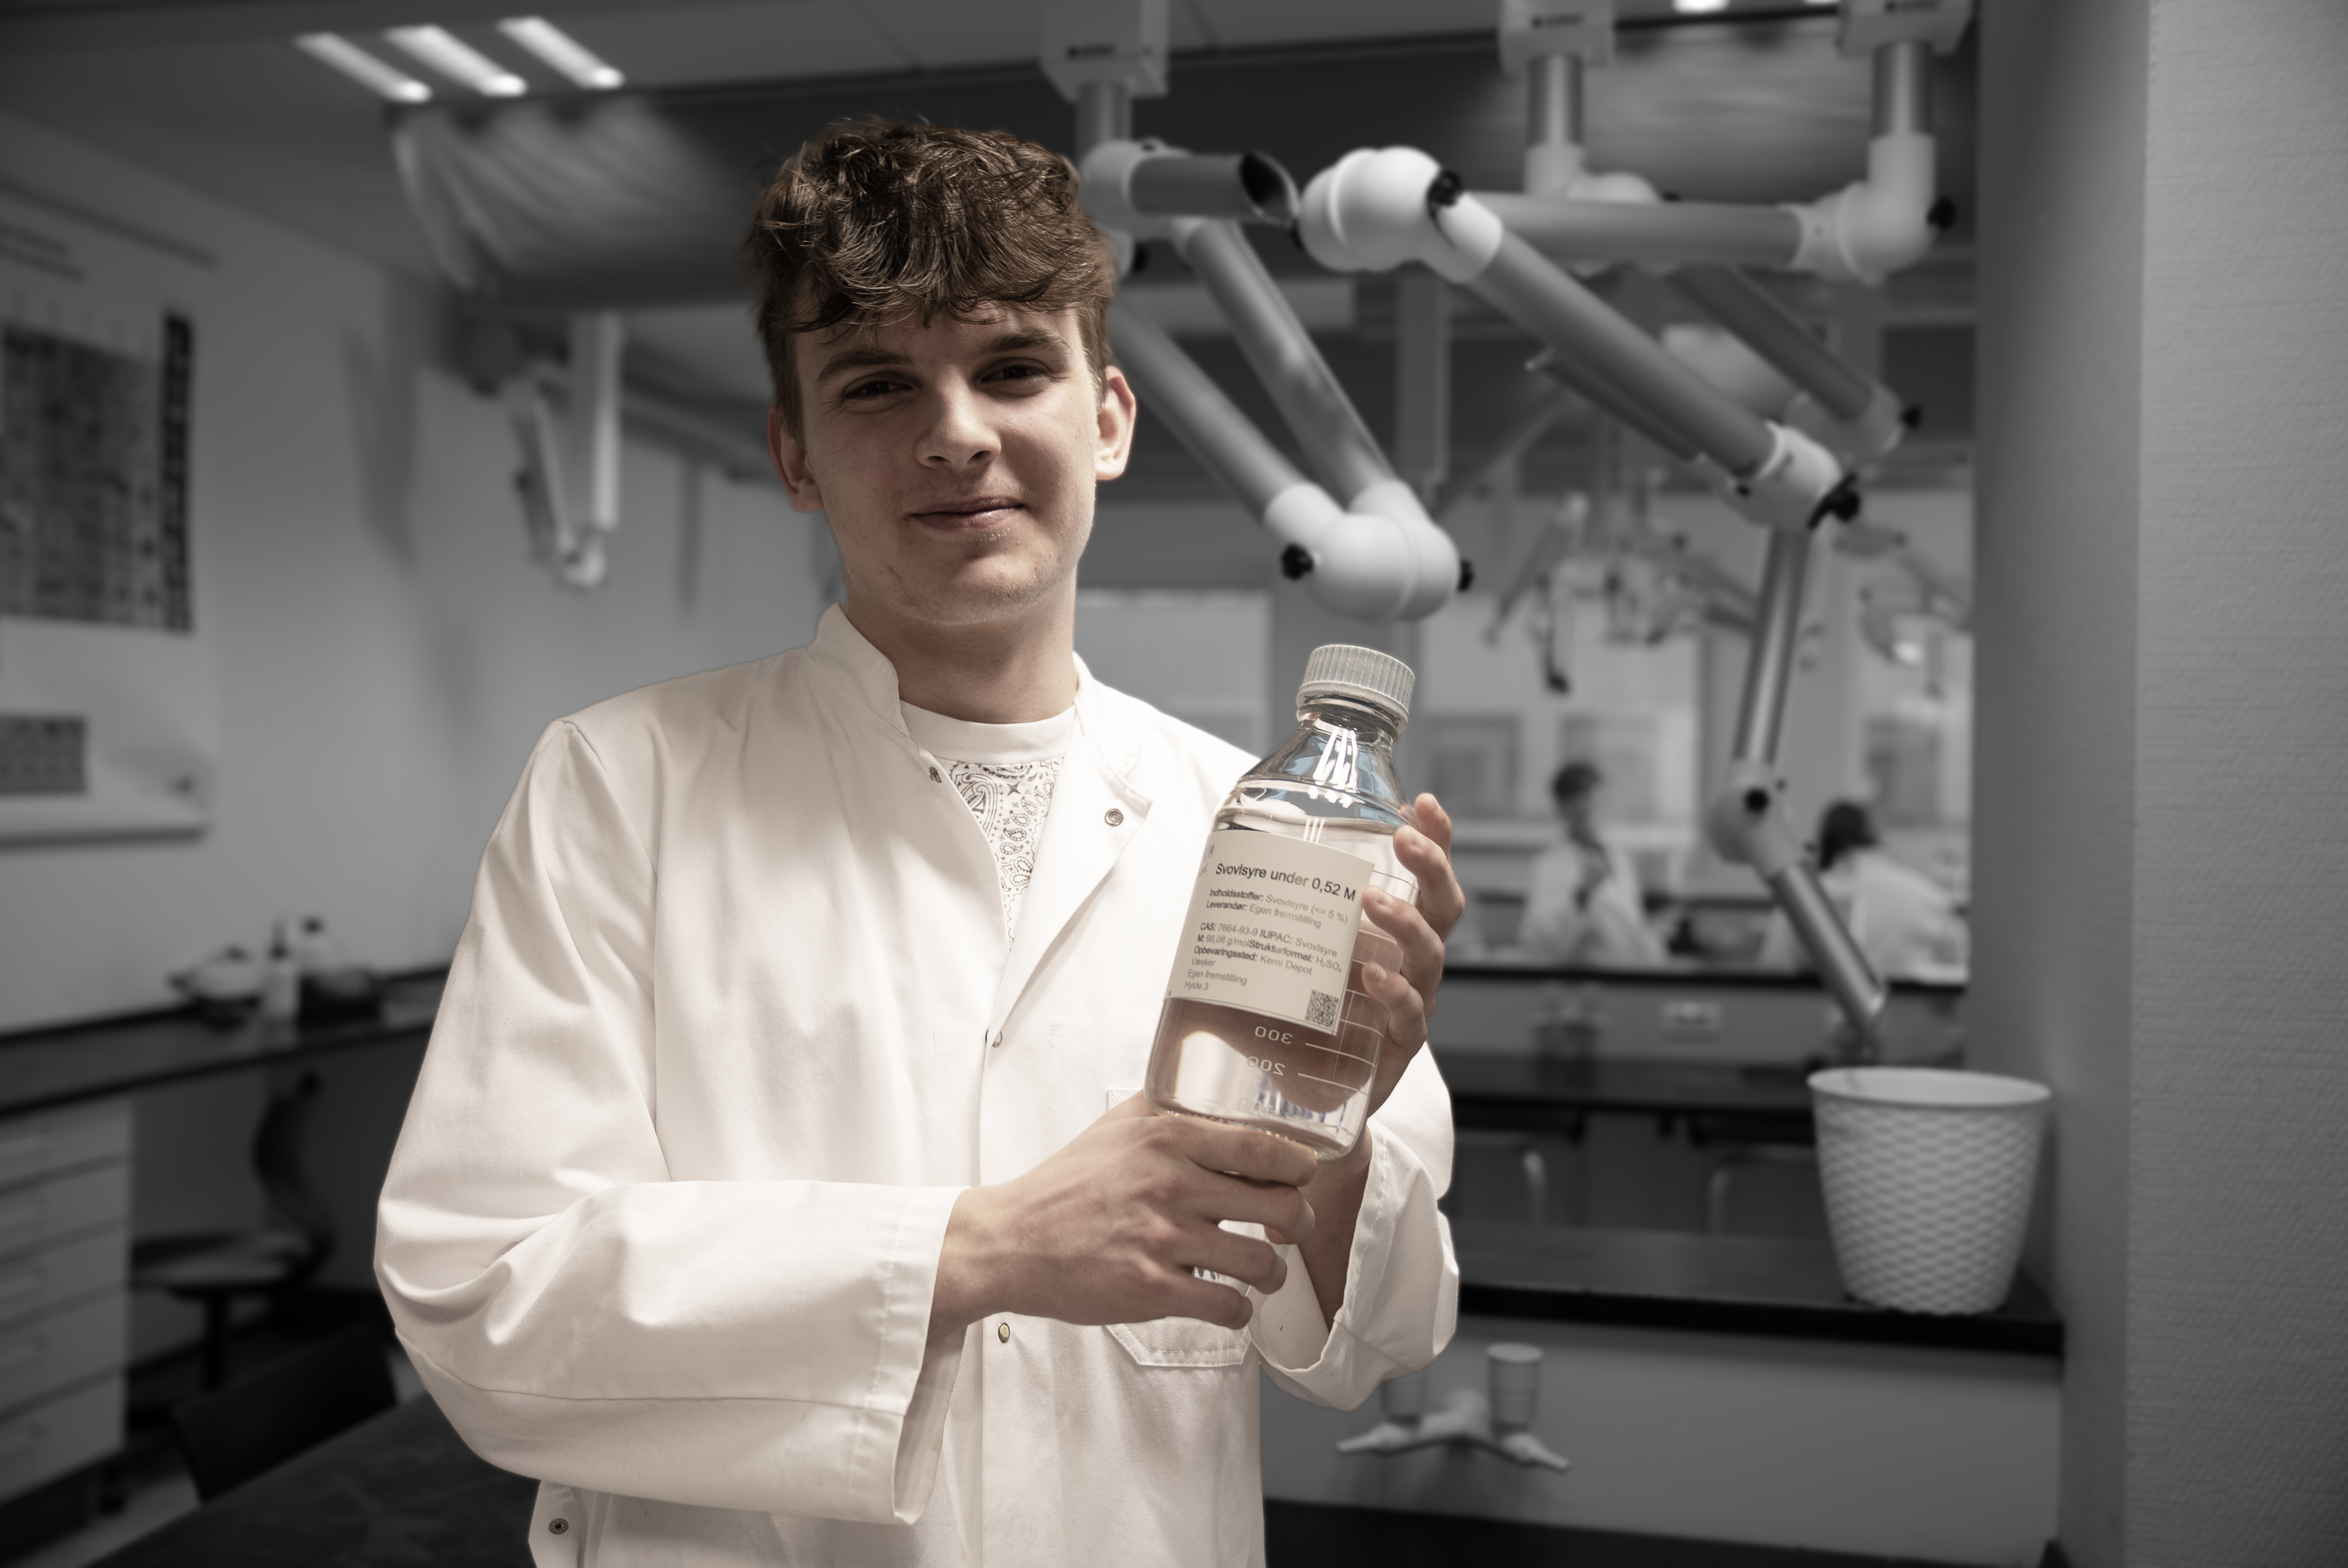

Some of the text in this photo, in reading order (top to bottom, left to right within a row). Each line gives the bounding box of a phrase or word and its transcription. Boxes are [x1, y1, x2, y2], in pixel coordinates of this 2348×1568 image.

[1216, 863, 1266, 879] Svovlsyre
[1270, 870, 1309, 886] under
[1312, 878, 1341, 896] 0,52
[1343, 887, 1356, 901] M
[1206, 900, 1321, 929] Leverandør: Egen fremstilling
[1209, 889, 1348, 925] Indholdsstoffer: Svovlsyre (<= 5 %)
[1200, 922, 1337, 957] CAS: 7664-93-9 IUPAC: Svovlsyre
[1206, 935, 1226, 945] 98,08
[1191, 957, 1216, 967] Væsker
[1194, 945, 1312, 976] Opbevaringssted: Kemi Depot
[1184, 981, 1209, 991] Hylde 3
[1187, 968, 1248, 986] Egen fremstilling
